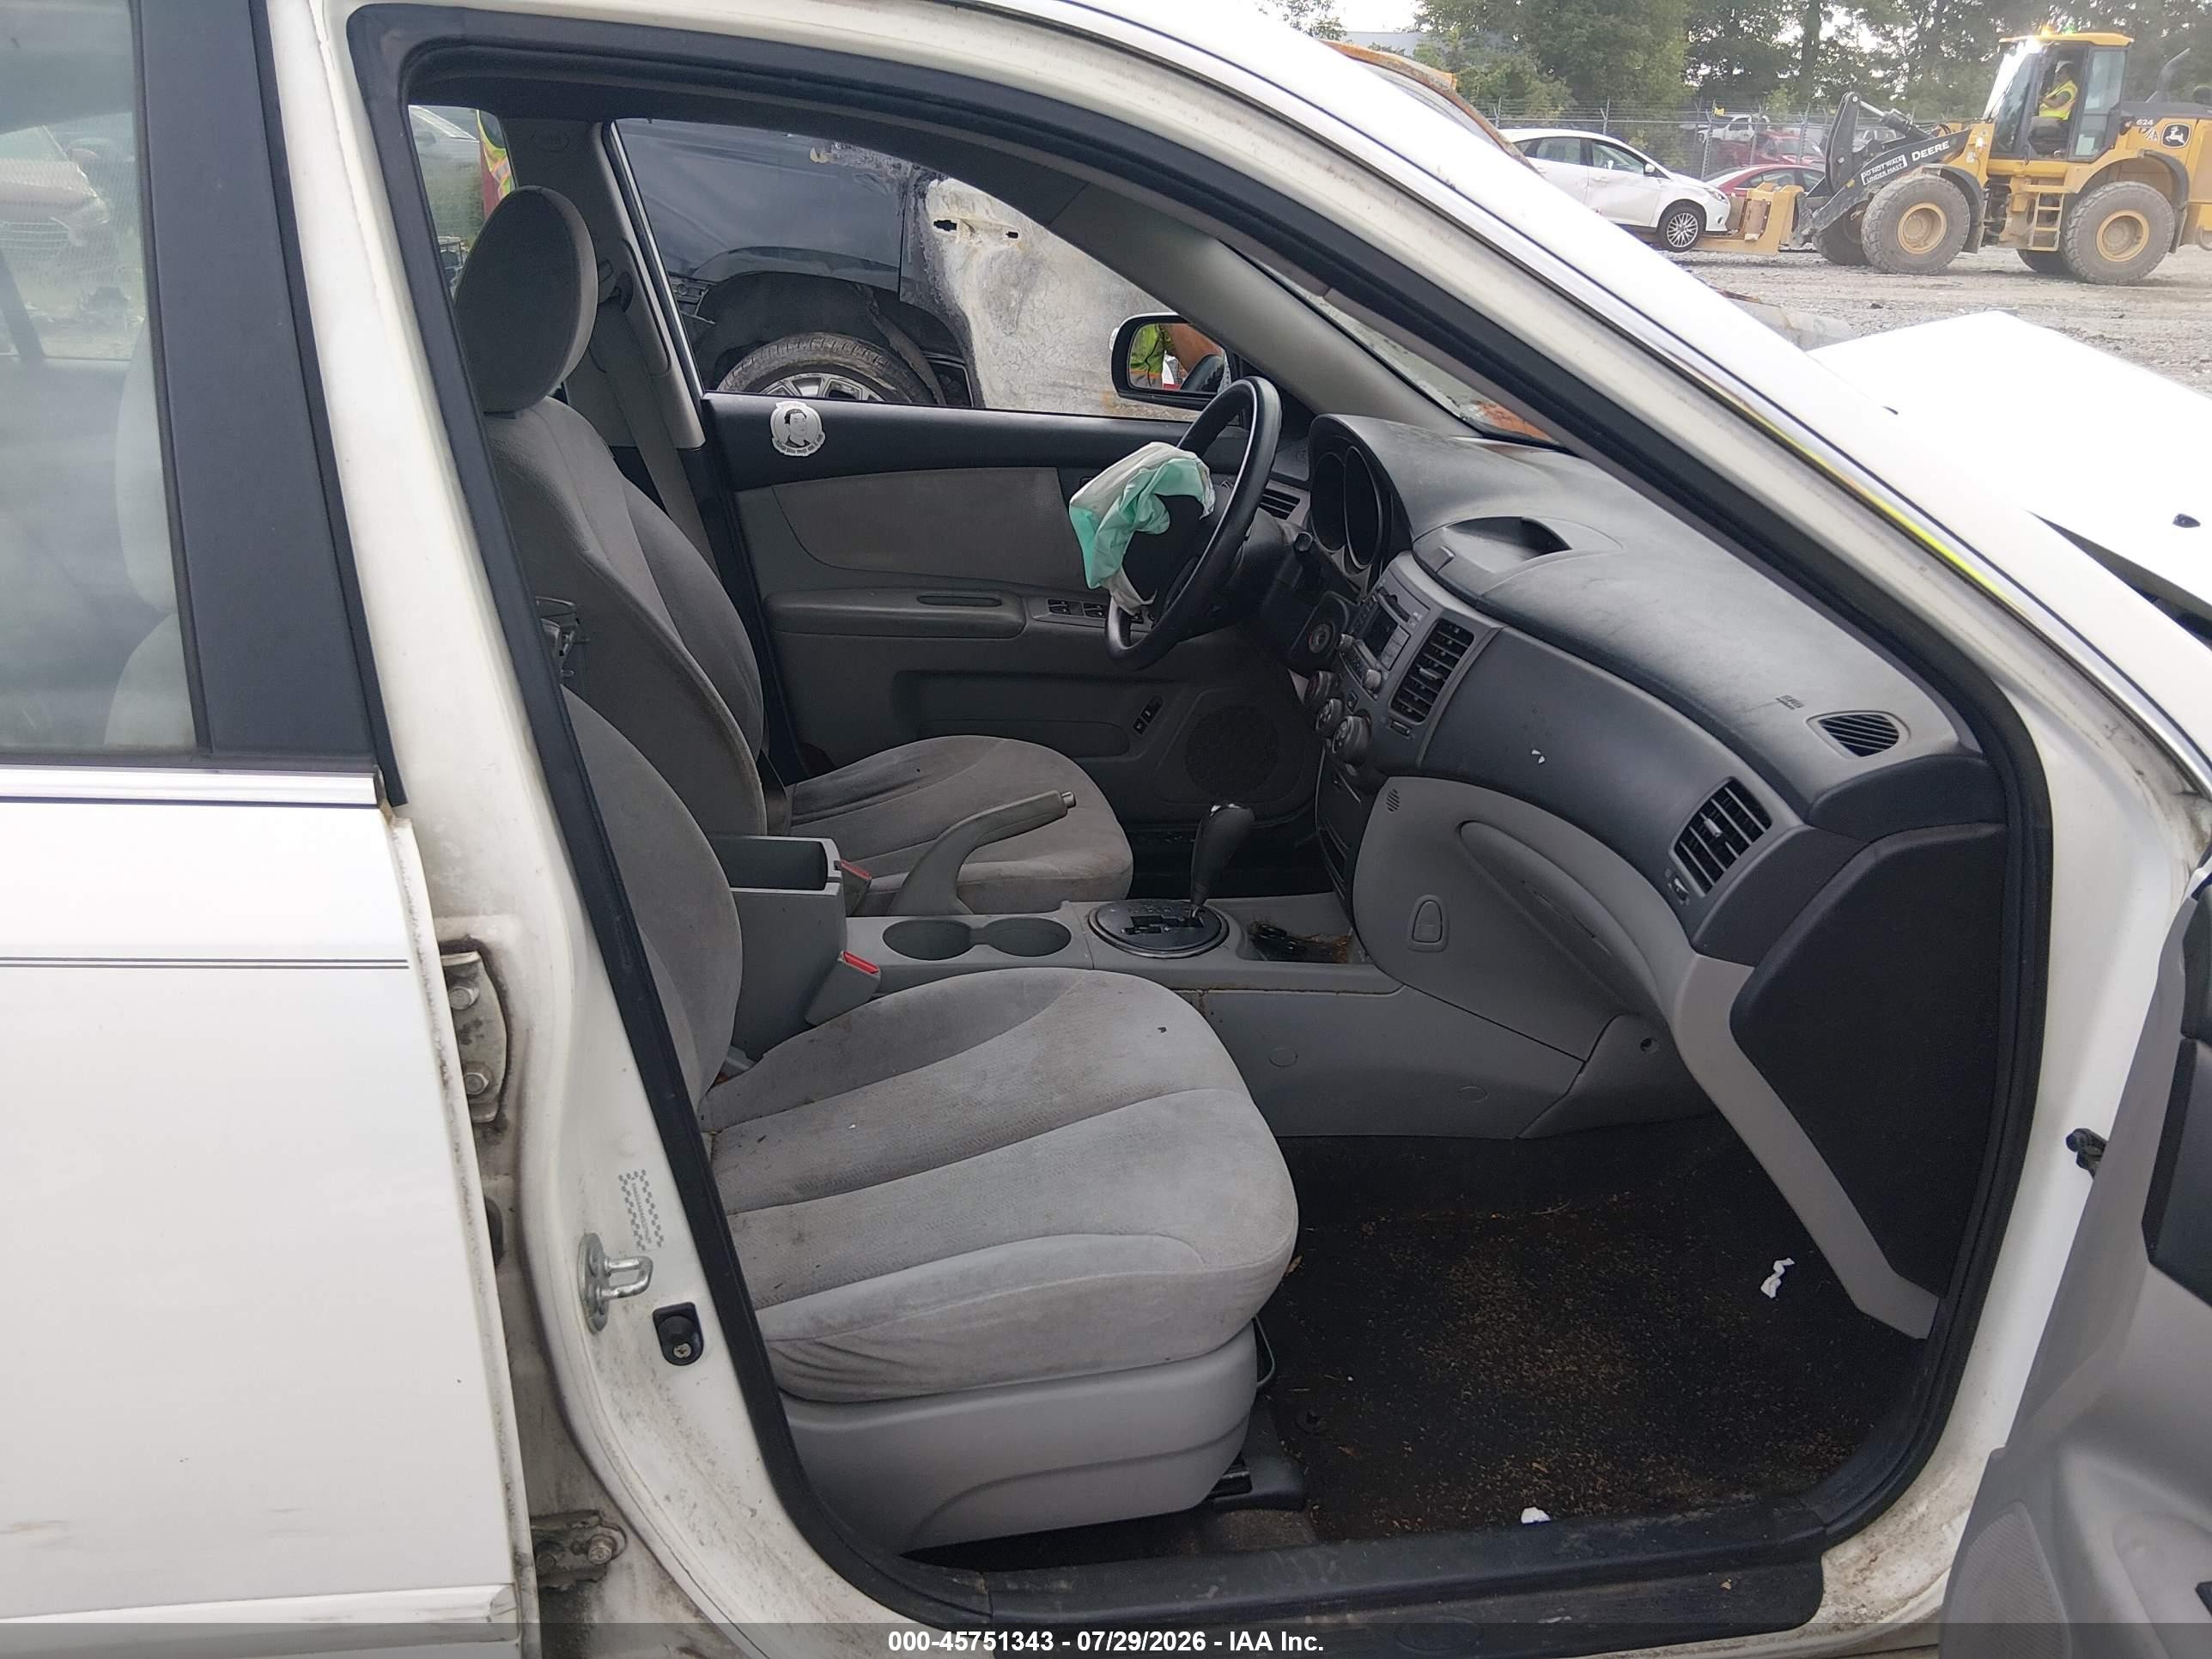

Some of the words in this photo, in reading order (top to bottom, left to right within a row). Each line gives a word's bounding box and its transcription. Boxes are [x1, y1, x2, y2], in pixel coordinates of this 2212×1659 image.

[1911, 140, 1950, 161] DEERE
[1866, 172, 1887, 183] UNDER
[1887, 162, 1903, 174] MAST
[1871, 164, 1885, 174] NOT
